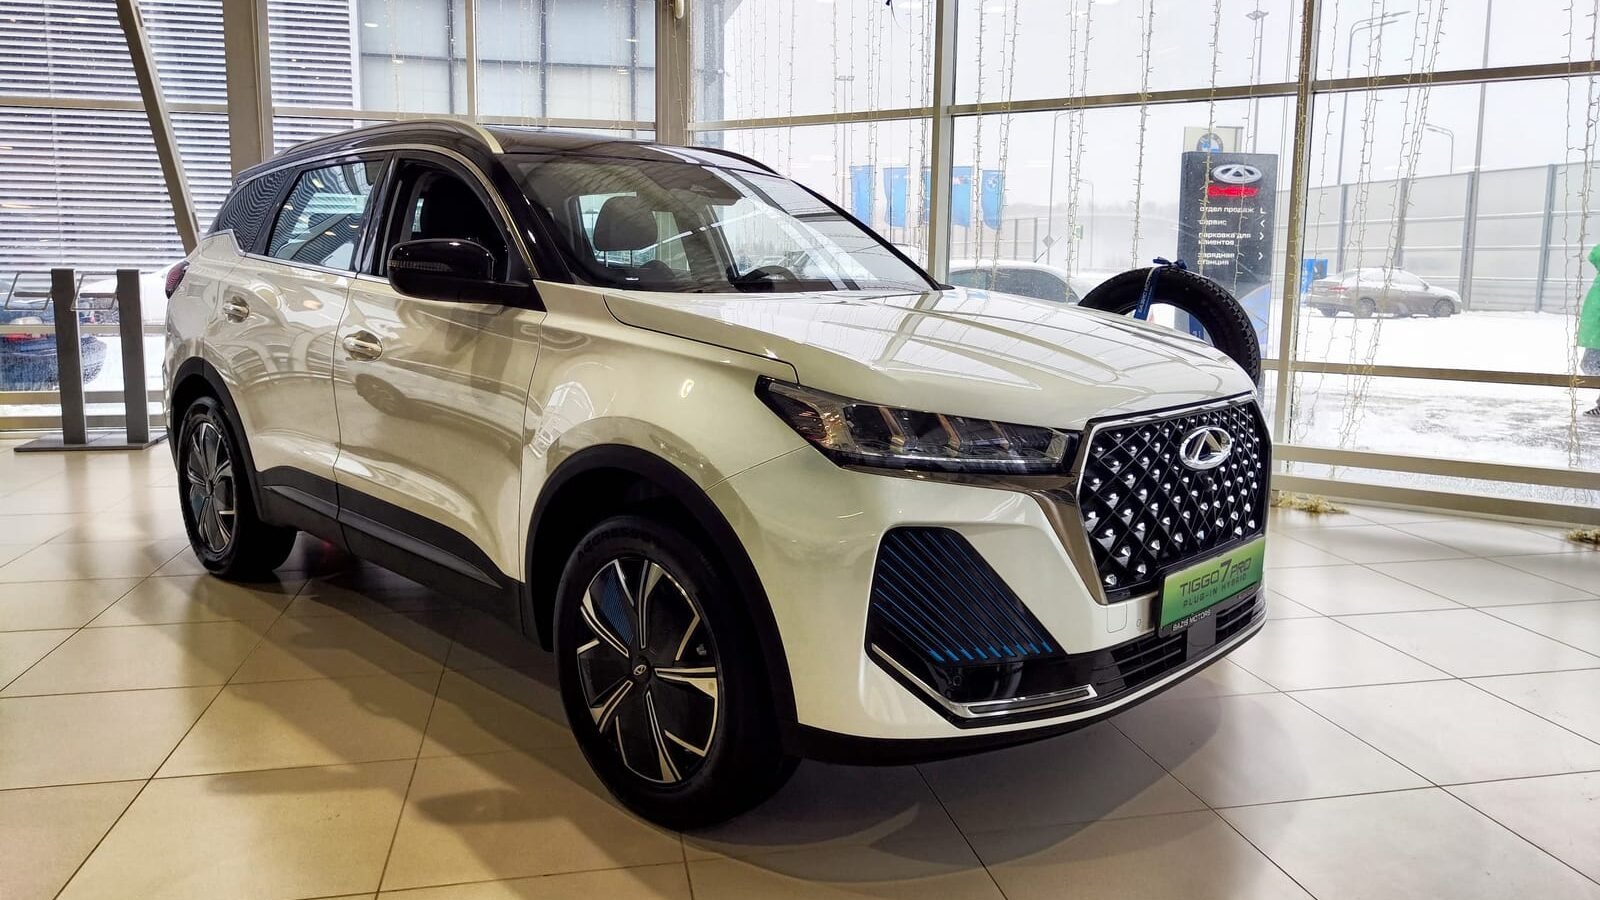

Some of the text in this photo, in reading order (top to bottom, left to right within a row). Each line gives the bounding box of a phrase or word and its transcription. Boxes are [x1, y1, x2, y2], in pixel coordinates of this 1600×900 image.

[1179, 557, 1252, 597] TIGGO 7 PRO
[1183, 573, 1247, 607] PLUG-IN HYBRID
